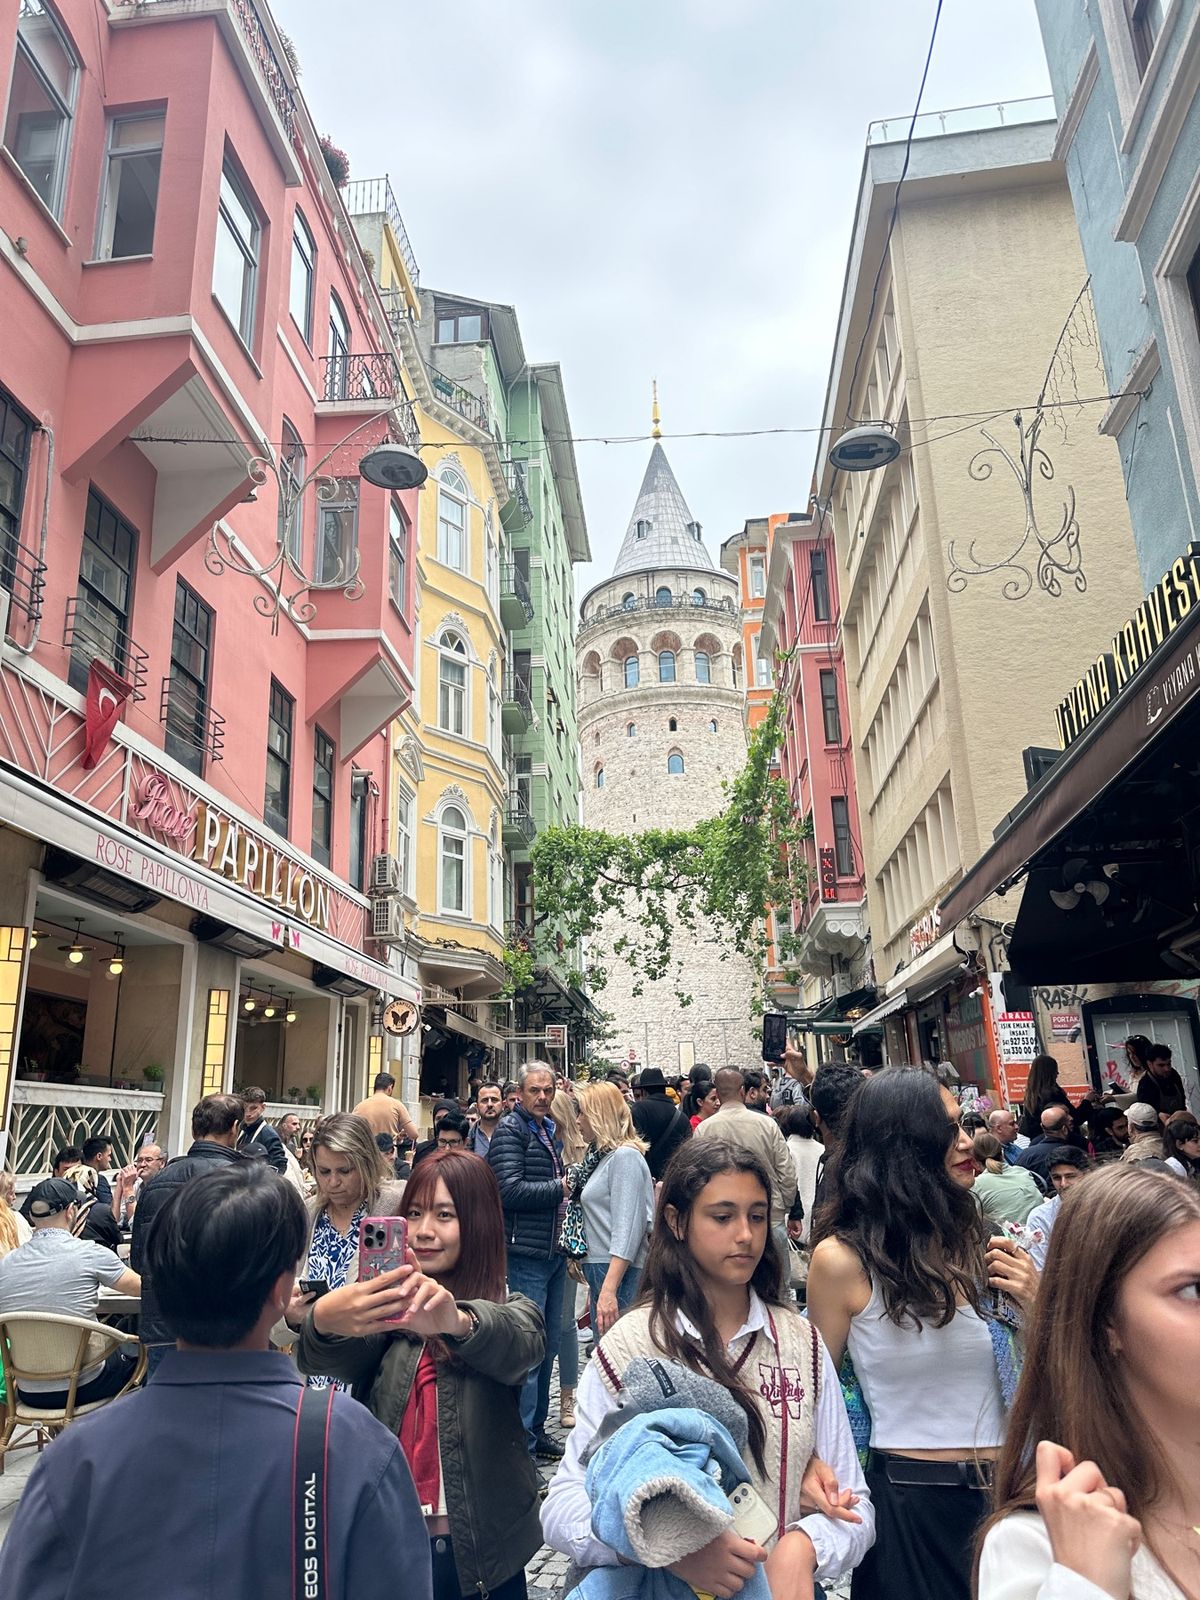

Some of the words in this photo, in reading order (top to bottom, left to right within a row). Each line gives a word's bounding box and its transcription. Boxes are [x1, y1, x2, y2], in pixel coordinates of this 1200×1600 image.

[95, 833, 134, 875] ROSE
[140, 855, 210, 910] PAPILLONYA
[197, 804, 330, 930] PAPILLON
[1010, 1037, 1021, 1046] 927
[1022, 1037, 1030, 1046] 53
[1011, 1046, 1022, 1055] 330
[1024, 1046, 1032, 1055] 00
[305, 1472, 317, 1551] DIGITAL
[304, 1556, 318, 1598] EOS
